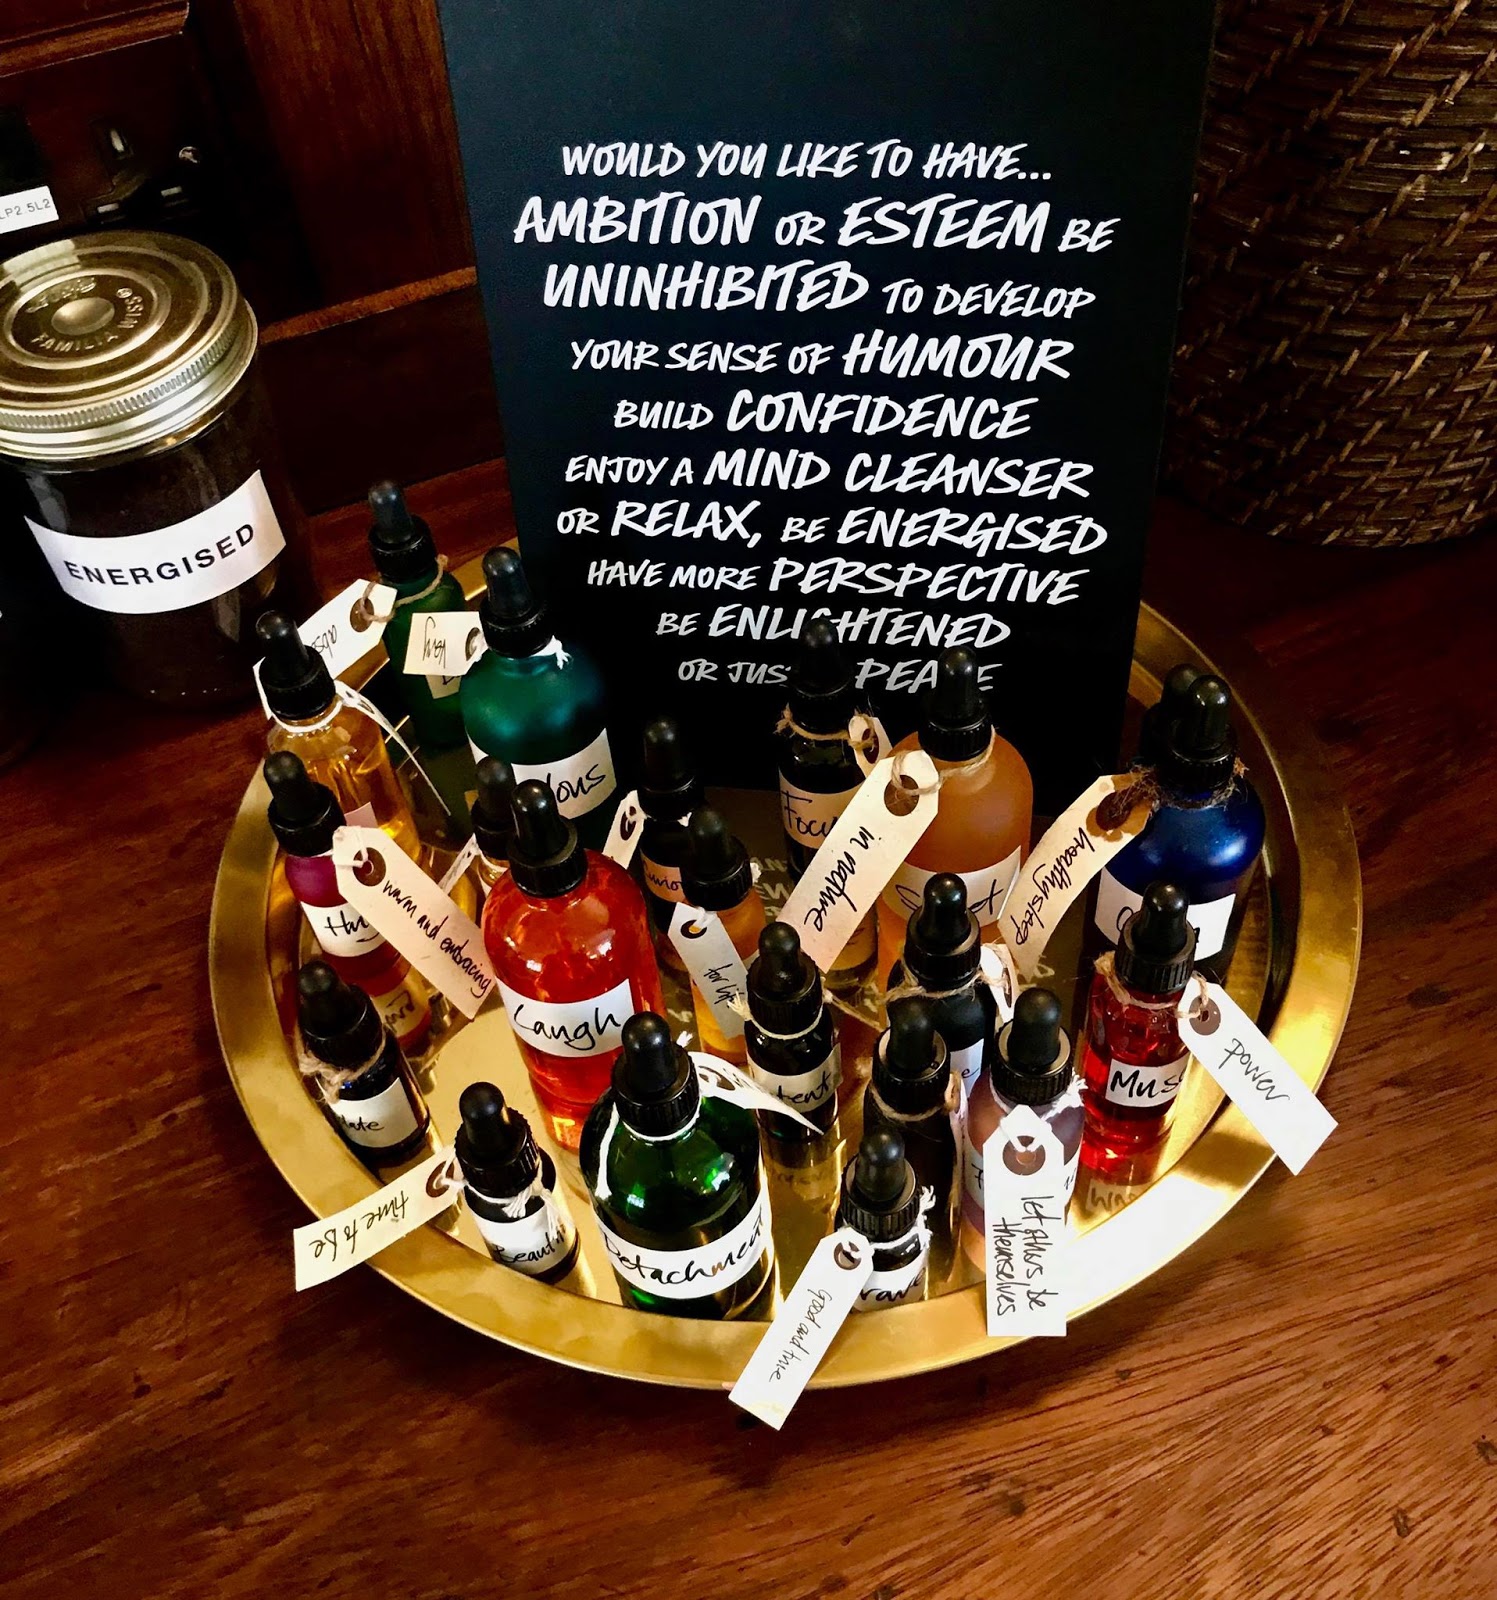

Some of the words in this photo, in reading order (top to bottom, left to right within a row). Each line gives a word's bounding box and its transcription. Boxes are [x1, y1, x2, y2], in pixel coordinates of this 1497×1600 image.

[563, 142, 685, 177] WOULD
[697, 141, 767, 178] YOU
[776, 142, 864, 178] LIKE
[867, 139, 913, 178] TO
[513, 192, 762, 245] AMBITION
[775, 211, 825, 245] OR
[838, 193, 1050, 252] ESTEEM
[1058, 218, 1120, 252] BE
[544, 260, 869, 312] UNINHIBITED
[882, 279, 923, 314] TO
[933, 281, 1096, 318] DEVELOP
[571, 339, 659, 370] YOUR
[665, 341, 782, 373] SENSE
[788, 343, 834, 374] OF
[842, 329, 1074, 381] HUMOUR
[614, 400, 713, 430] BUILD
[727, 389, 1039, 439] CONFIDENCE
[565, 455, 669, 485] ENJOY
[670, 458, 693, 486] A
[703, 448, 830, 490] MIND
[845, 453, 1093, 500] CLEANSER
[63, 521, 256, 587] ENERGISED
[557, 508, 599, 534] OR
[611, 500, 761, 548] RELAX,
[780, 517, 830, 543] BE
[837, 507, 1107, 557] ENERGISED
[588, 559, 666, 586] HAVE
[669, 565, 761, 590] MORE
[769, 557, 1089, 605] PERSPECTIVE
[656, 613, 700, 635] BE
[679, 659, 718, 681] OR
[728, 662, 791, 683] JUS
[855, 658, 1002, 693] PEAE
[780, 790, 838, 829] Focu
[850, 825, 884, 851] in
[803, 850, 857, 933] nature
[382, 879, 417, 921] warm
[416, 916, 441, 943] and
[440, 936, 492, 999] embracing
[513, 1004, 622, 1050] Laugh
[992, 1217, 1020, 1317] themselves
